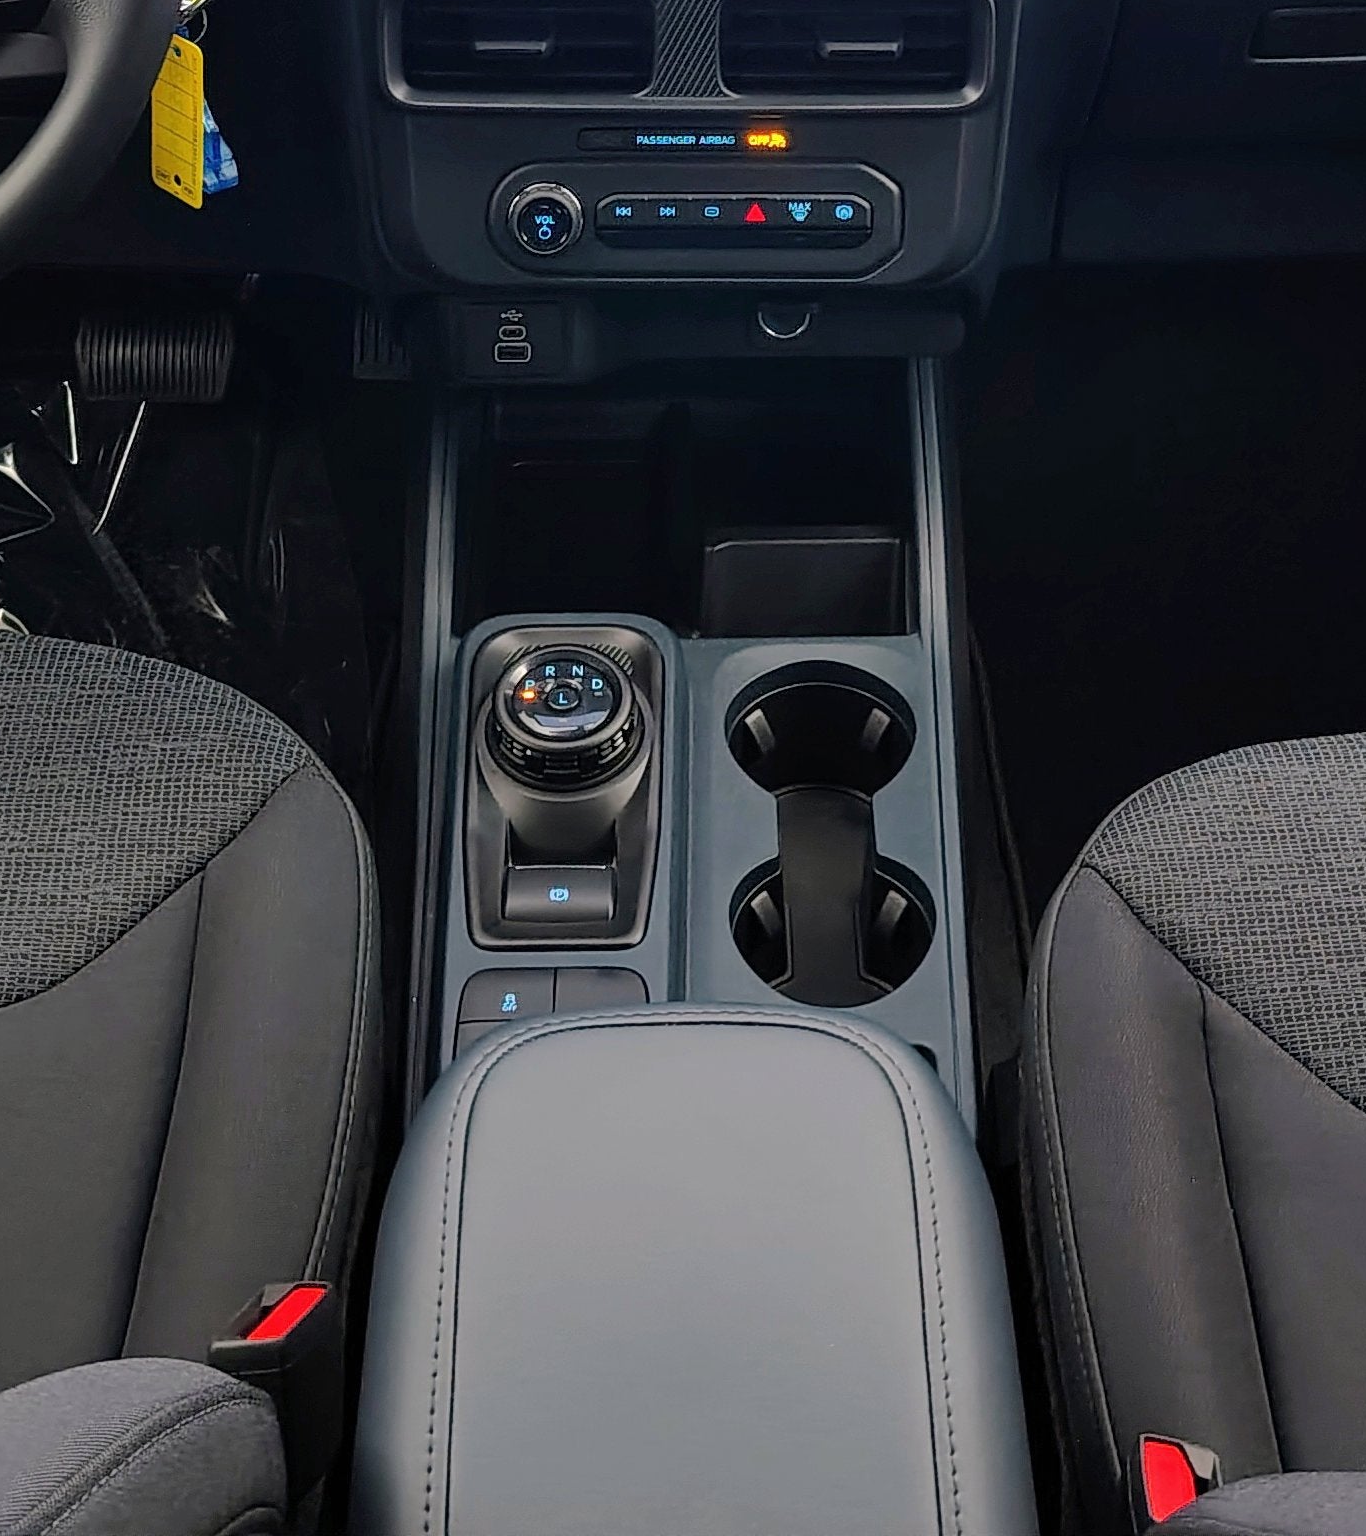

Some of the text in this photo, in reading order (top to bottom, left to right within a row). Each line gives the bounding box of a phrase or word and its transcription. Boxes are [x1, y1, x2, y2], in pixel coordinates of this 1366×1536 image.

[636, 135, 736, 145] PASSENGER AIRBAG
[789, 202, 812, 212] MAX
[535, 215, 556, 225] VOL
[546, 666, 556, 676] R
[573, 665, 584, 676] N
[525, 679, 536, 691] P
[592, 679, 603, 690] D
[559, 693, 569, 704] L
